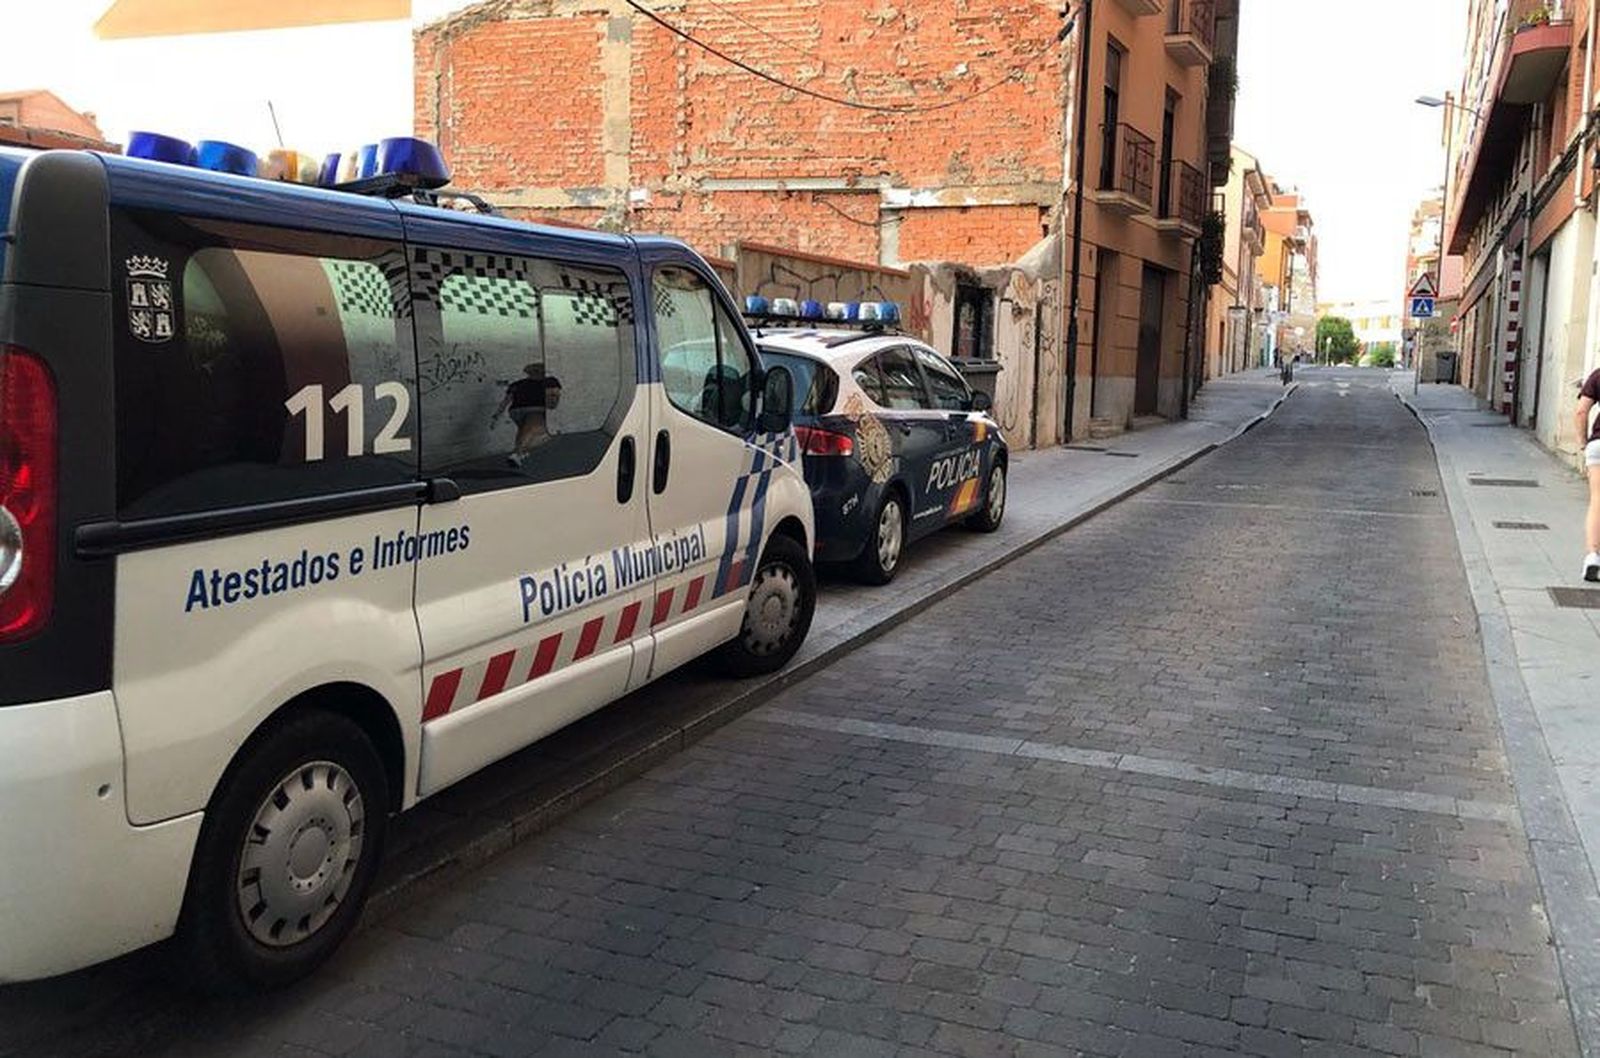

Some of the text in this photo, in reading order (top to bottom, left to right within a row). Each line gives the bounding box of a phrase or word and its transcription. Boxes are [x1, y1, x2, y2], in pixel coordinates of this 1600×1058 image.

[285, 382, 412, 462] 112
[185, 523, 471, 613] Atestados e Informes
[519, 523, 707, 623] Policía Municipal
